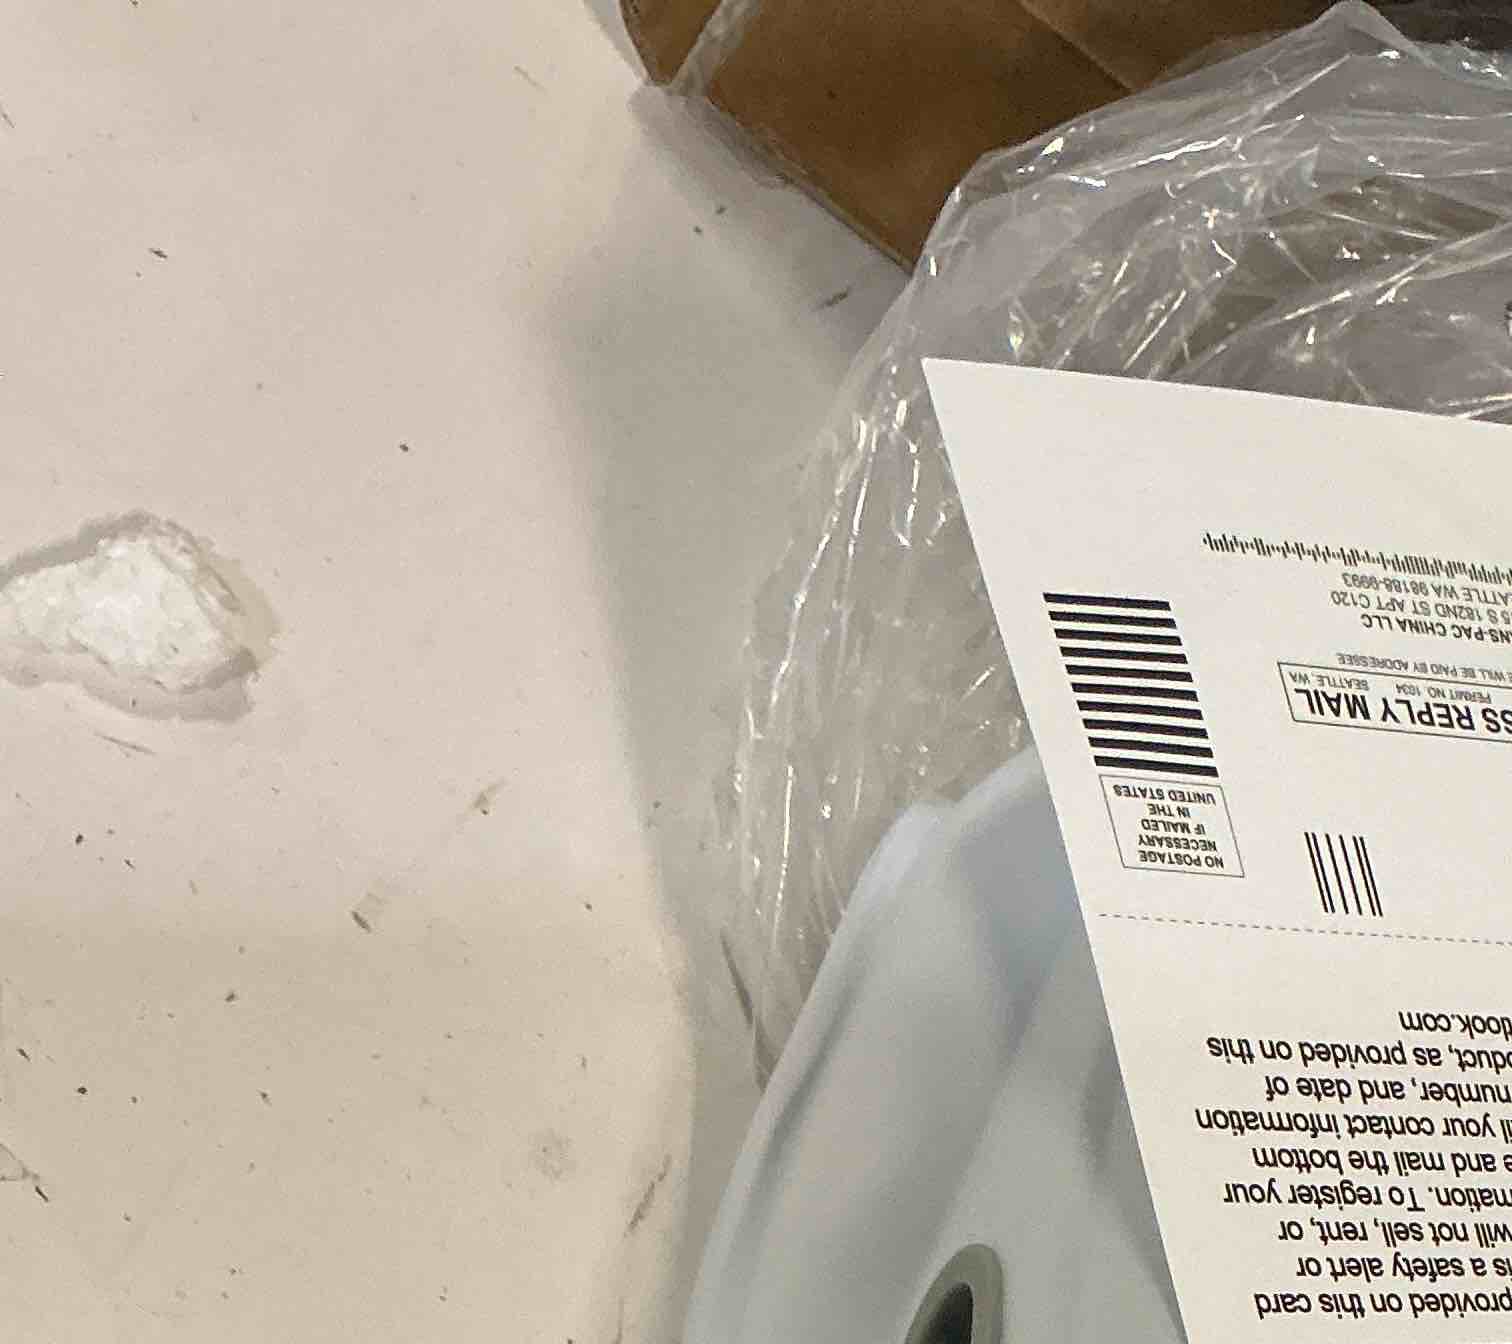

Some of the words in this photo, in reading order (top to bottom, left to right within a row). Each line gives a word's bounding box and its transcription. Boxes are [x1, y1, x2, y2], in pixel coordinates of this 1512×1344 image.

[1293, 687, 1372, 721] MAIL
[1379, 695, 1477, 732] REPLY
[1111, 783, 1166, 802] STATES
[1166, 788, 1217, 807] UNITED
[1146, 802, 1176, 818] THE
[1175, 804, 1192, 819] IN
[1139, 817, 1193, 835] MAILED
[1193, 822, 1207, 836] IF
[1137, 833, 1219, 853] NECESSARY
[1136, 849, 1203, 868] POSTAGE
[1203, 854, 1225, 870] NO
[1205, 1036, 1257, 1066] this
[1257, 1039, 1294, 1061] on
[1296, 1038, 1409, 1071] provided
[1411, 1046, 1444, 1068] as
[1263, 1074, 1291, 1103] of
[1295, 1072, 1353, 1106] date
[1356, 1078, 1407, 1106] and
[1409, 1076, 1512, 1110] number,
[1193, 1107, 1343, 1141] information
[1342, 1111, 1436, 1141] contact
[1441, 1111, 1498, 1139] your
[1250, 1146, 1345, 1177] bottom
[1346, 1149, 1391, 1177] the
[1391, 1150, 1447, 1178] mail
[1449, 1151, 1498, 1179] and
[1222, 1176, 1284, 1205] your
[1286, 1178, 1384, 1212] register
[1387, 1185, 1427, 1213] To
[1277, 1220, 1305, 1241] or
[1308, 1215, 1370, 1248] rent,
[1372, 1216, 1425, 1249] sell,
[1426, 1221, 1471, 1248] not
[1295, 1256, 1323, 1278] or
[1324, 1256, 1386, 1285] alert
[1391, 1250, 1466, 1284] safety
[1468, 1256, 1489, 1278] a
[1252, 1289, 1313, 1321] card
[1317, 1292, 1367, 1321] this
[1368, 1292, 1404, 1314] on
